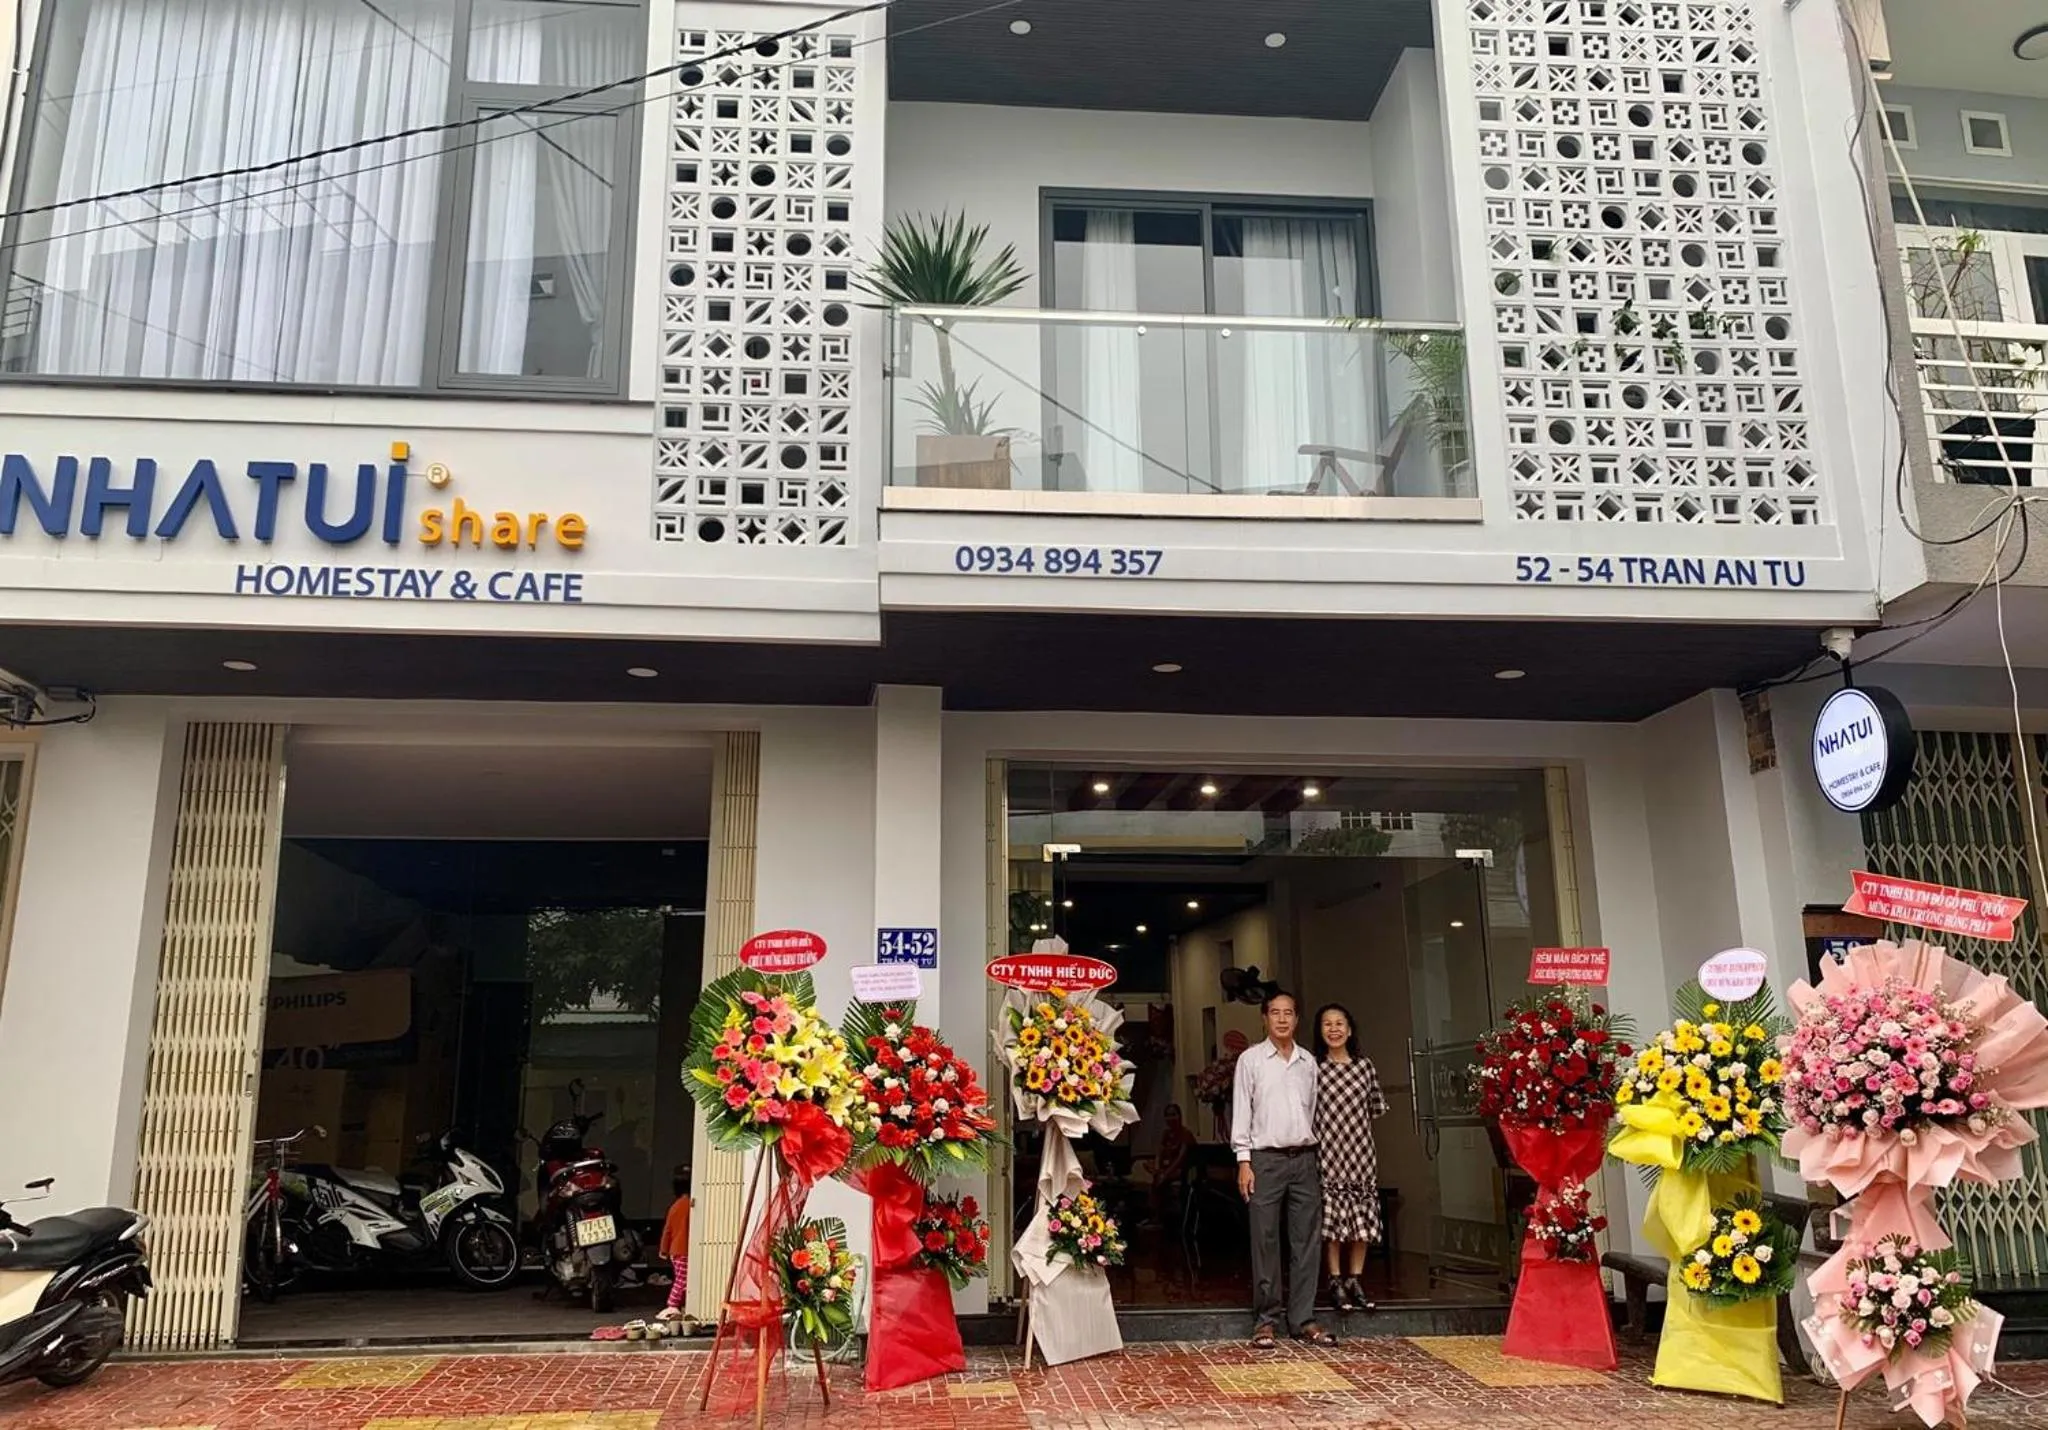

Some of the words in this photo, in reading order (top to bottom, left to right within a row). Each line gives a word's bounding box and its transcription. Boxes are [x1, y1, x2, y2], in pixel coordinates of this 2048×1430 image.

[418, 497, 586, 550] share
[956, 545, 1035, 573] 0934
[1044, 548, 1102, 575] 894
[1110, 549, 1163, 576] 357
[1516, 556, 1551, 582] 52
[1577, 557, 1614, 583] 54
[1619, 557, 1705, 585] TRAN
[1714, 559, 1757, 585] AN
[1763, 560, 1806, 587] TU
[235, 565, 443, 600] HOMESTAY
[450, 571, 476, 600] &
[489, 571, 584, 602] CAFE
[1865, 761, 1881, 775] CAFE
[1861, 881, 1878, 895] CTY
[881, 932, 935, 956] 54-52
[991, 963, 1015, 976] CTY
[1018, 965, 1053, 977] TNHH
[1089, 964, 1113, 980] ĐỨC
[272, 991, 347, 1010] PHILIPS
